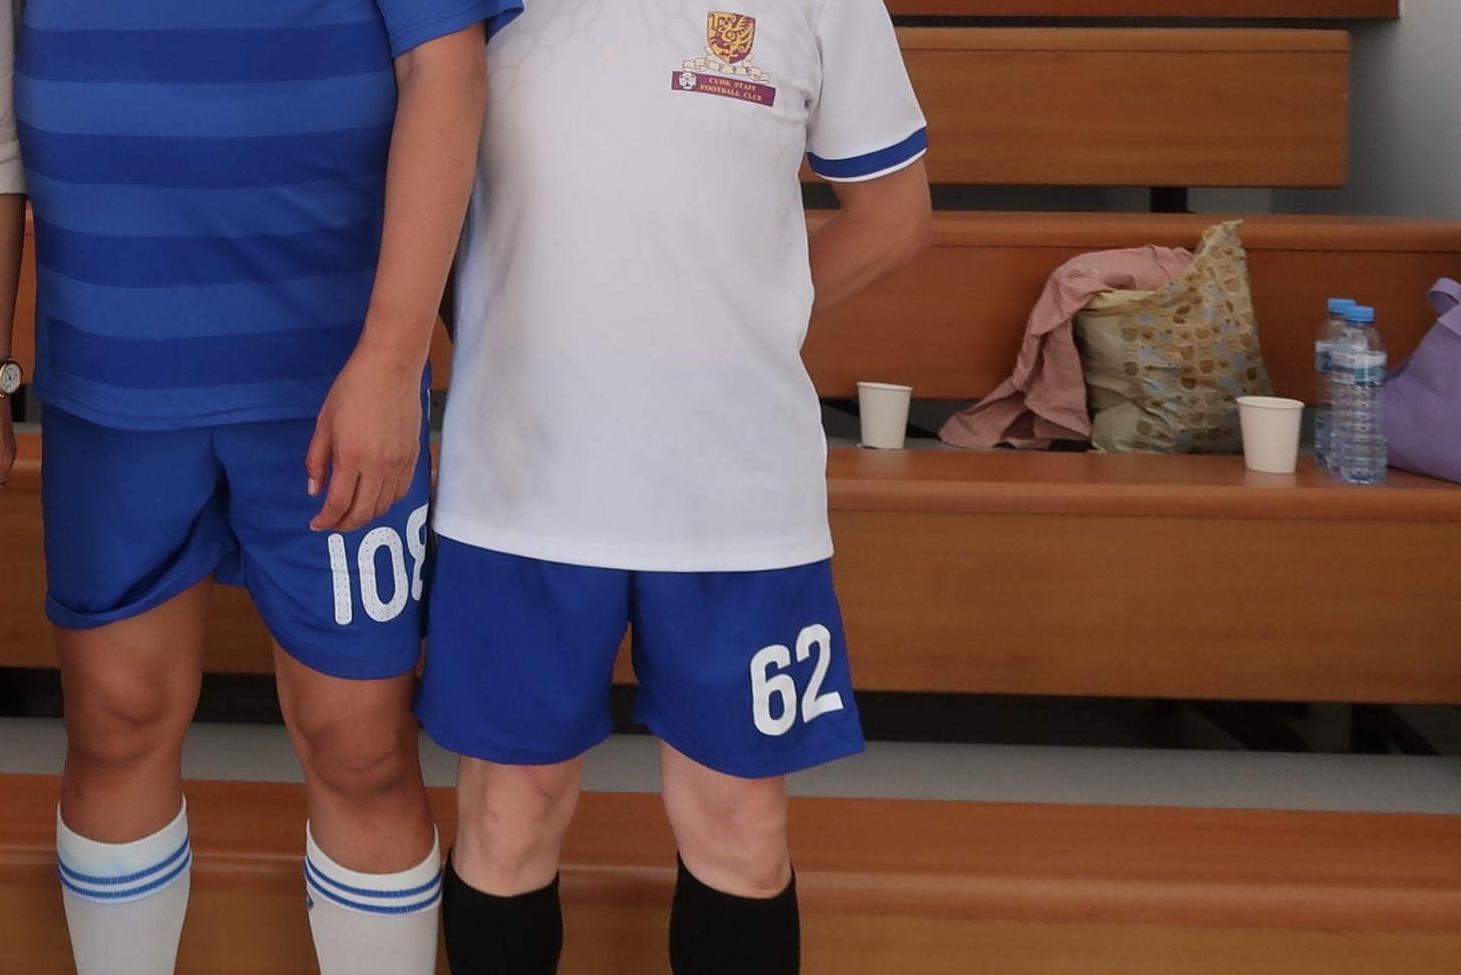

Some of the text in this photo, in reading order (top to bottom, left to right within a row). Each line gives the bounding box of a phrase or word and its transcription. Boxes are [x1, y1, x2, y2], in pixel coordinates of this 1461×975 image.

[699, 84, 763, 102] FOOTBALL CLUB
[750, 623, 845, 737] 62
